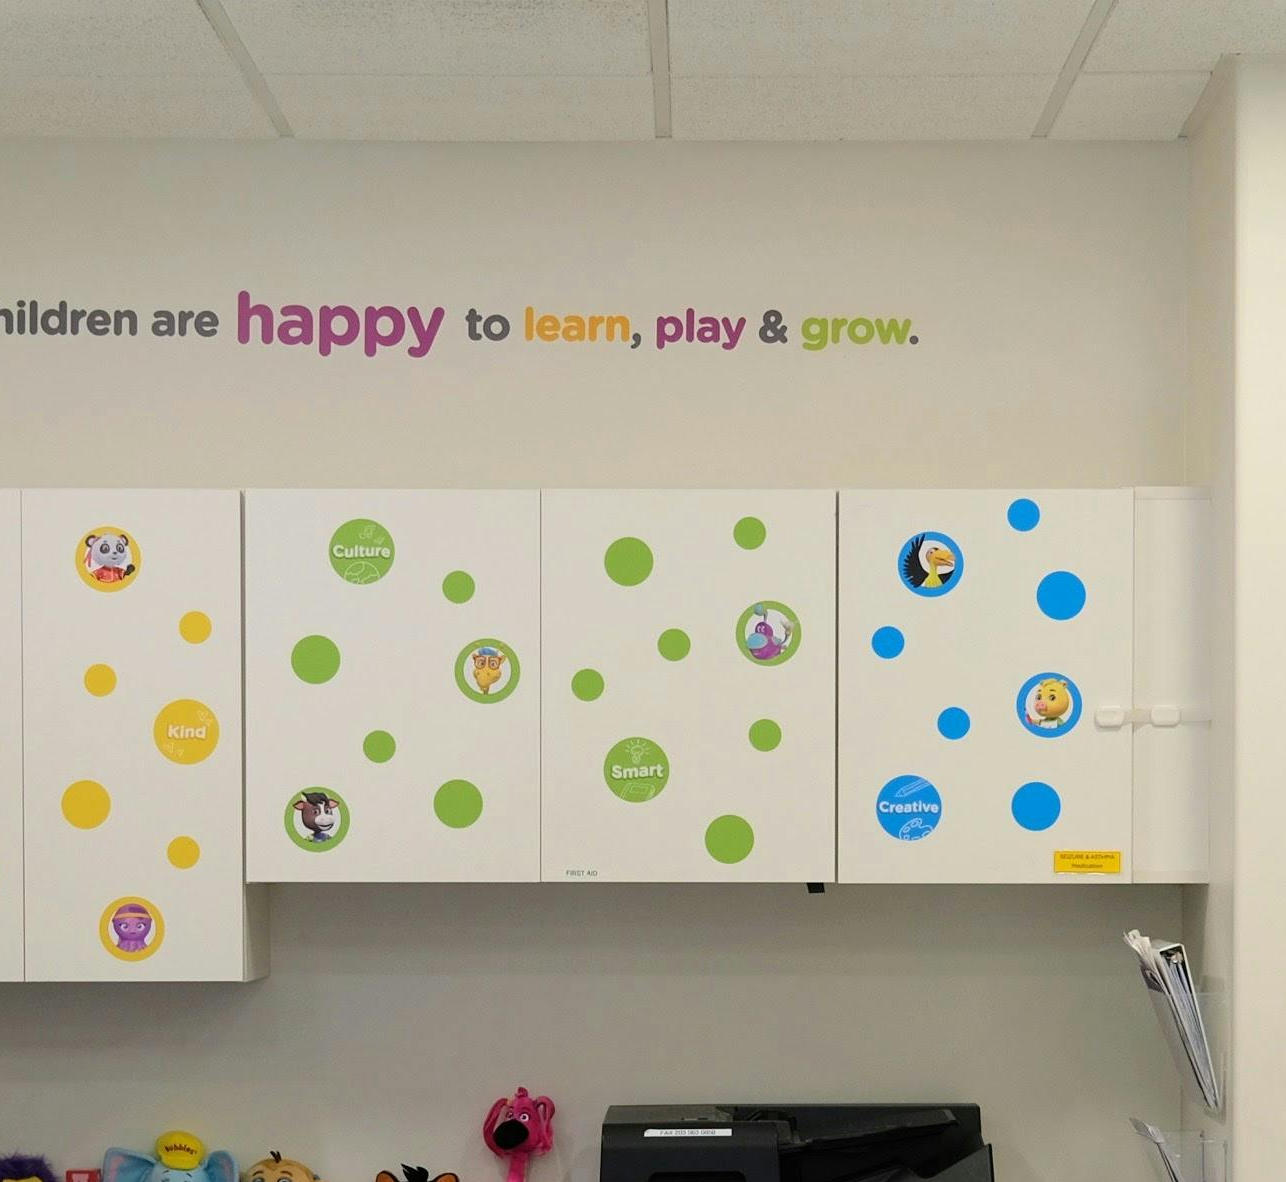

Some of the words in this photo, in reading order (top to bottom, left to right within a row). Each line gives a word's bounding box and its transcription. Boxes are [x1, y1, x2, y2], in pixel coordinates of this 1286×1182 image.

[151, 306, 220, 337] are
[237, 290, 446, 358] happy
[466, 308, 511, 342] to
[524, 306, 643, 350] learn,
[657, 308, 747, 350] play
[758, 309, 789, 345] &
[801, 309, 920, 351] grow.
[332, 544, 391, 559] Culture
[167, 724, 206, 739] Kind
[611, 764, 664, 779] Smart
[878, 800, 940, 814] Creative
